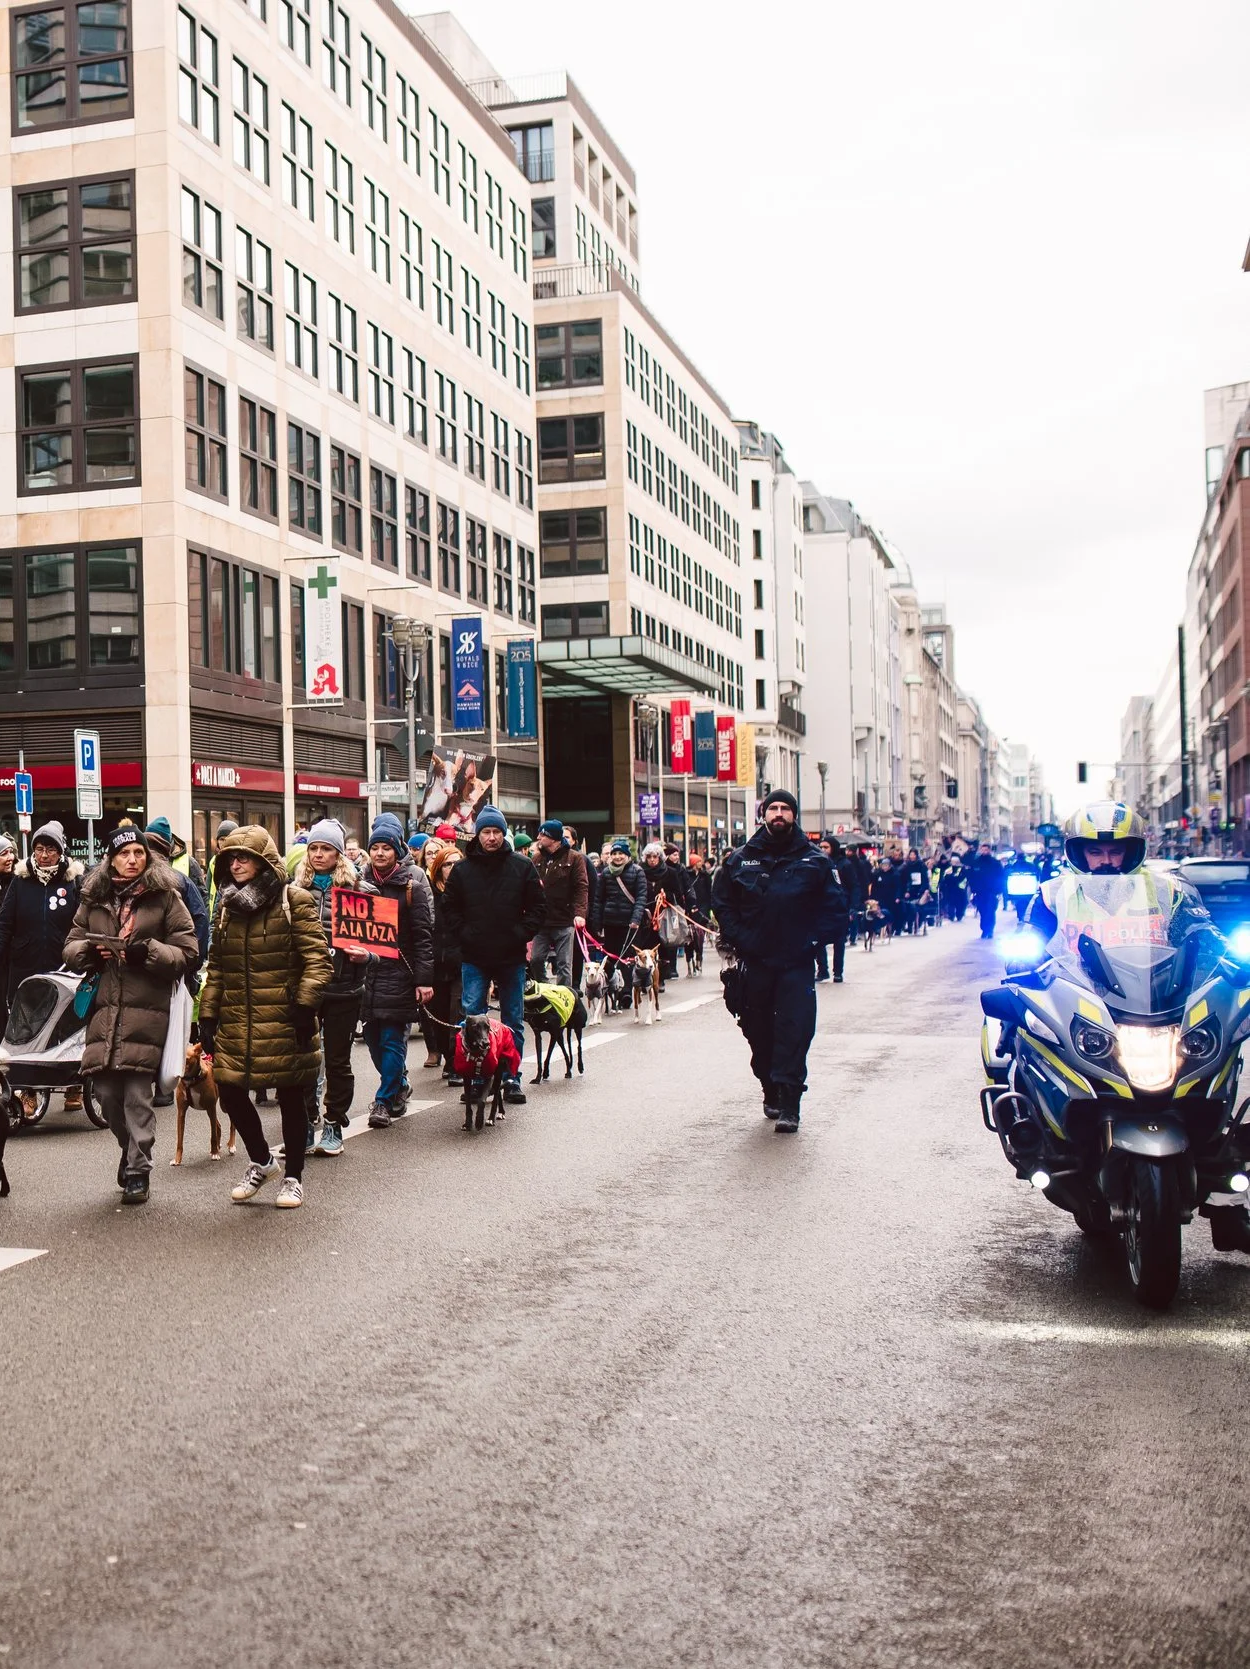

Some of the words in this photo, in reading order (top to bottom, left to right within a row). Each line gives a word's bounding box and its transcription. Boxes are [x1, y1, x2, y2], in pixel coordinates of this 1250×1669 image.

[718, 730, 730, 771] REWE
[0, 778, 15, 786] FOO
[72, 838, 102, 849] Fresly
[341, 894, 369, 919] NO
[339, 920, 349, 935] A
[349, 921, 363, 938] LA
[365, 921, 397, 943] CAZA
